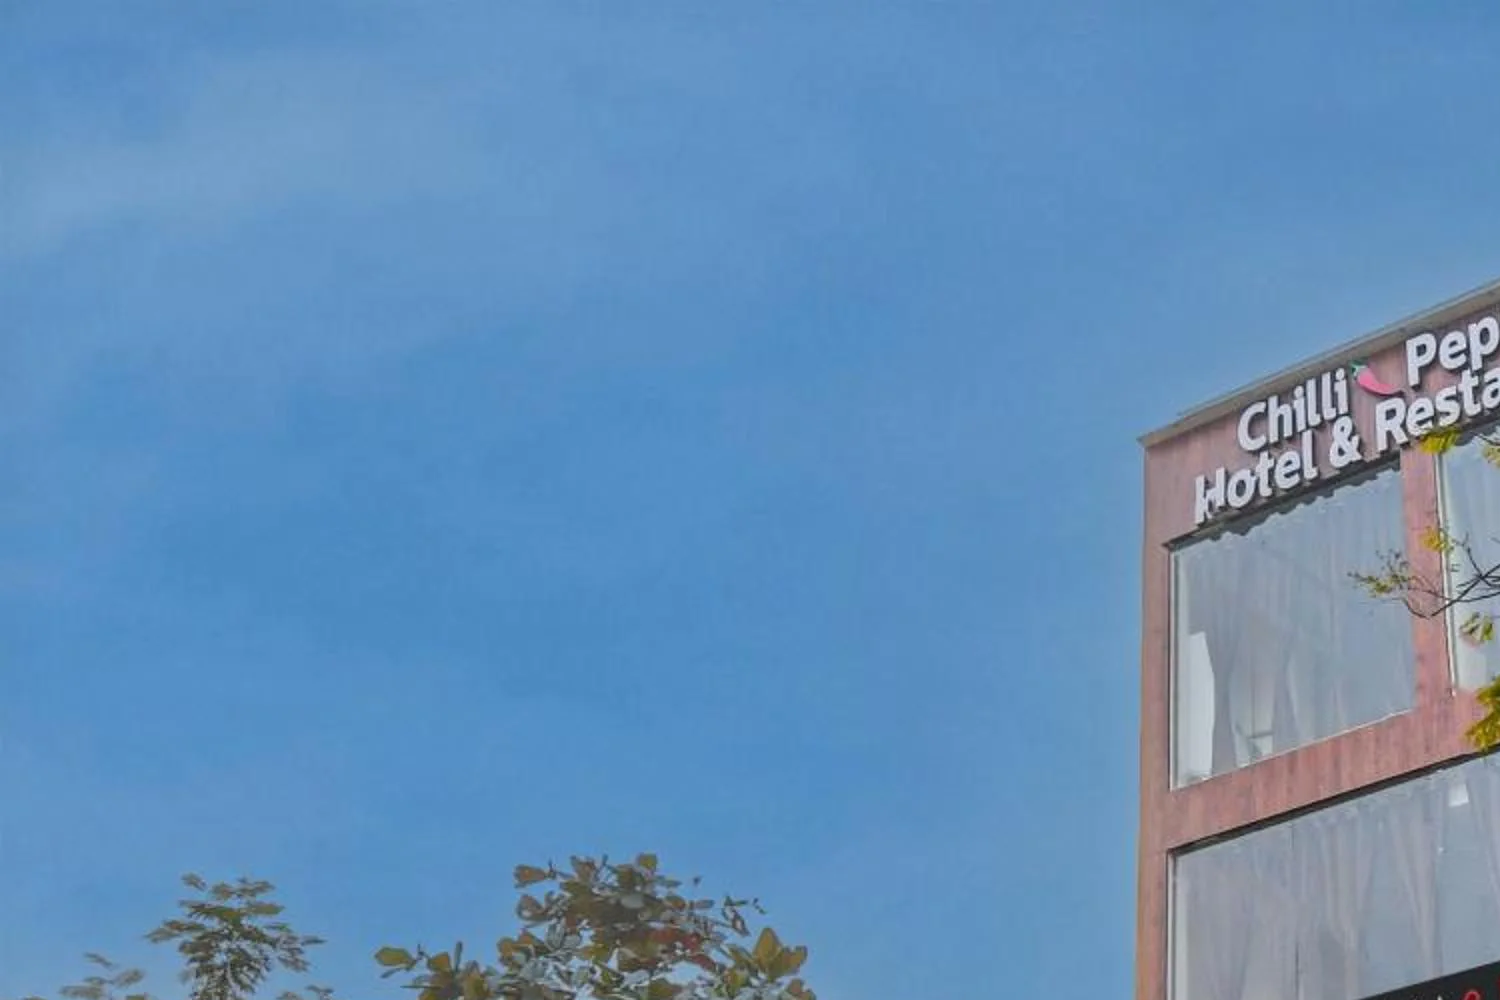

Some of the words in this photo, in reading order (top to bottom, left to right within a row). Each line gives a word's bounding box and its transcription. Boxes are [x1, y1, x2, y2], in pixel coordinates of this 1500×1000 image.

[1236, 368, 1349, 452] Chilli
[1194, 429, 1317, 524] Hotel
[1329, 421, 1364, 469] &
